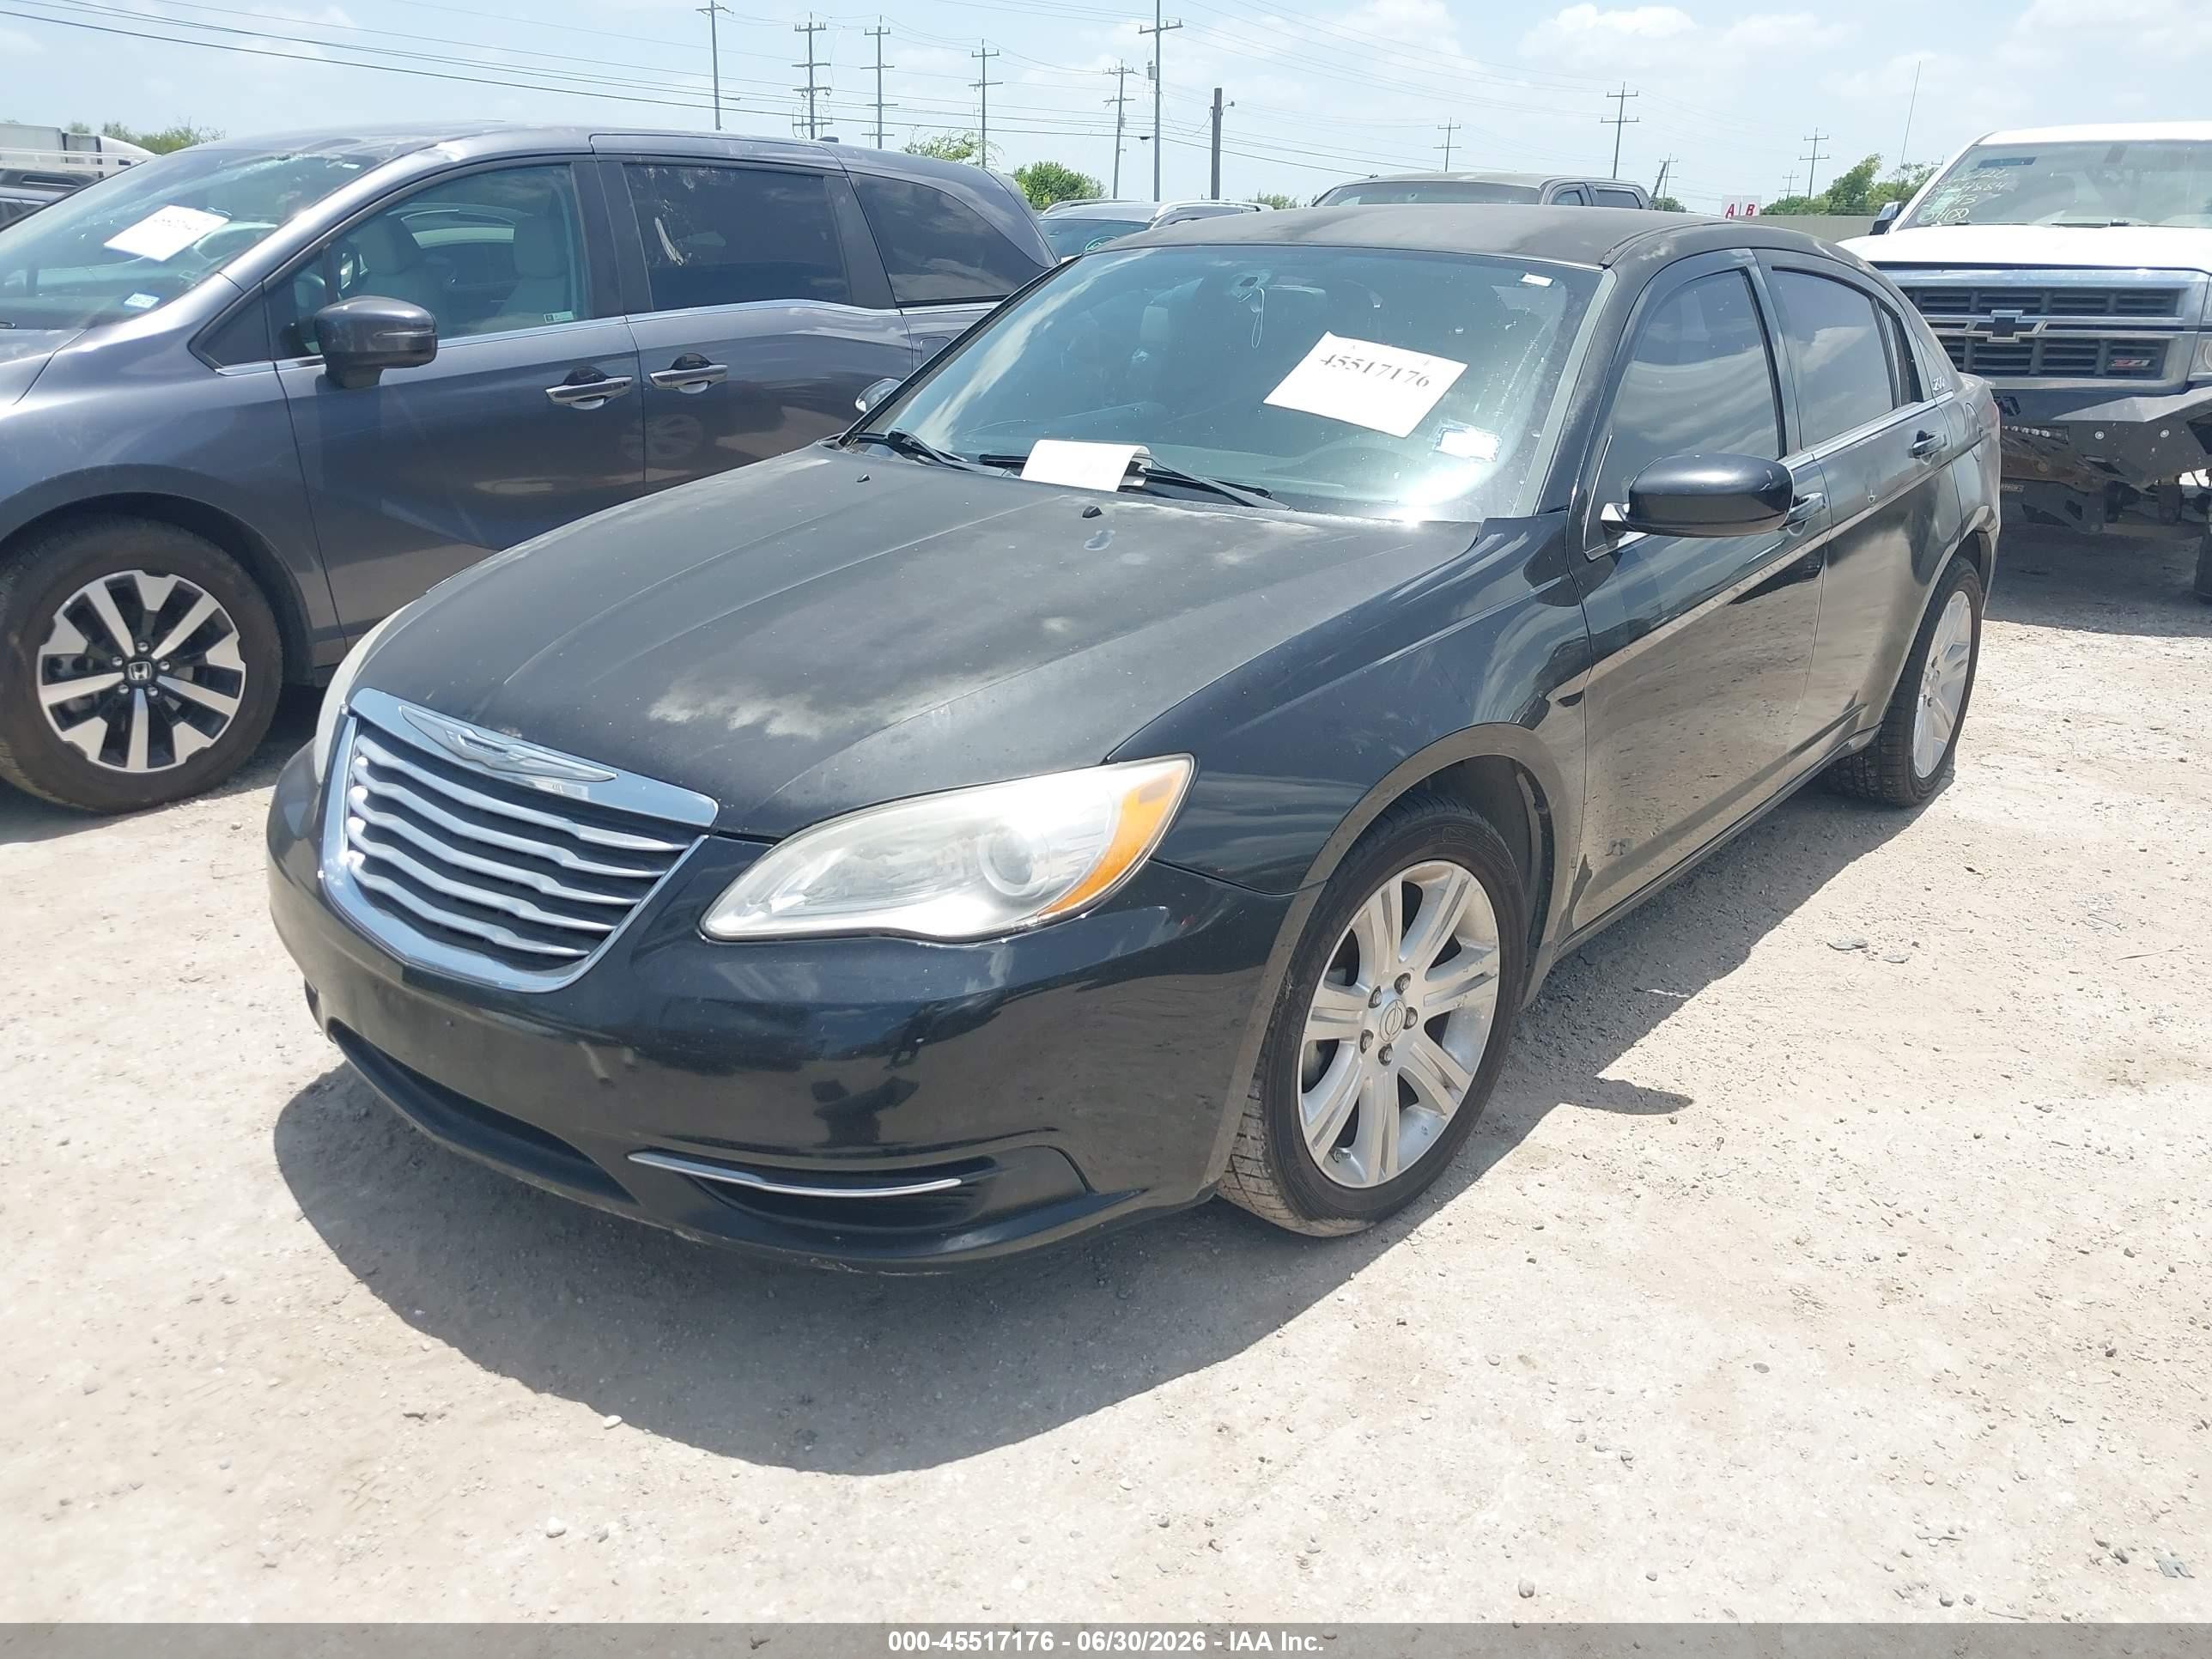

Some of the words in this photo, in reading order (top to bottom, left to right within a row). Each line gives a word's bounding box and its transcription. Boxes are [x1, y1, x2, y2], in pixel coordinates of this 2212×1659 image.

[1725, 203, 1735, 218] A
[1745, 204, 1755, 216] B
[1319, 354, 1431, 387] 45517176
